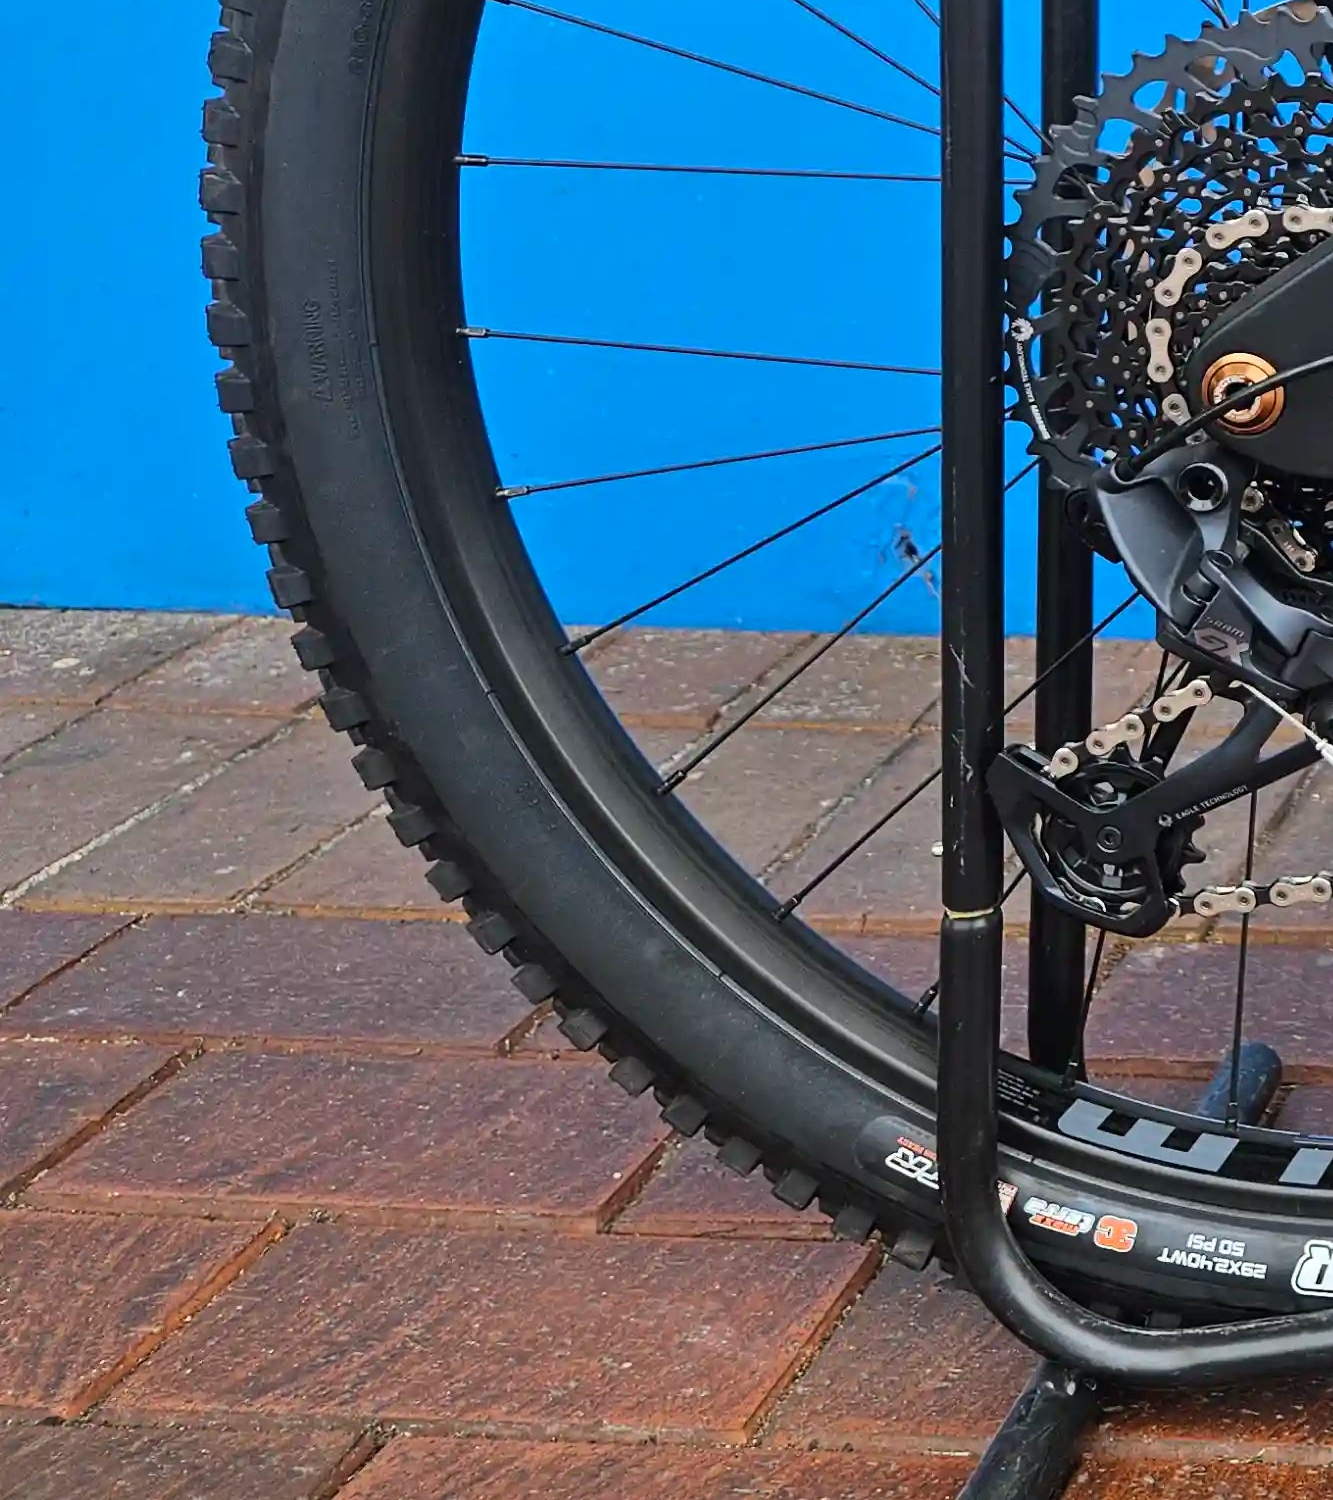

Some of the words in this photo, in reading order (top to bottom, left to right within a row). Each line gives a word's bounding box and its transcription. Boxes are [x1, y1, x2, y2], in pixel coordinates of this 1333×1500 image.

[1175, 804, 1201, 820] EAGLE
[1199, 784, 1249, 809] TECHNOLOGY
[1186, 1232, 1217, 1252] PSI
[1218, 1239, 1247, 1257] 50
